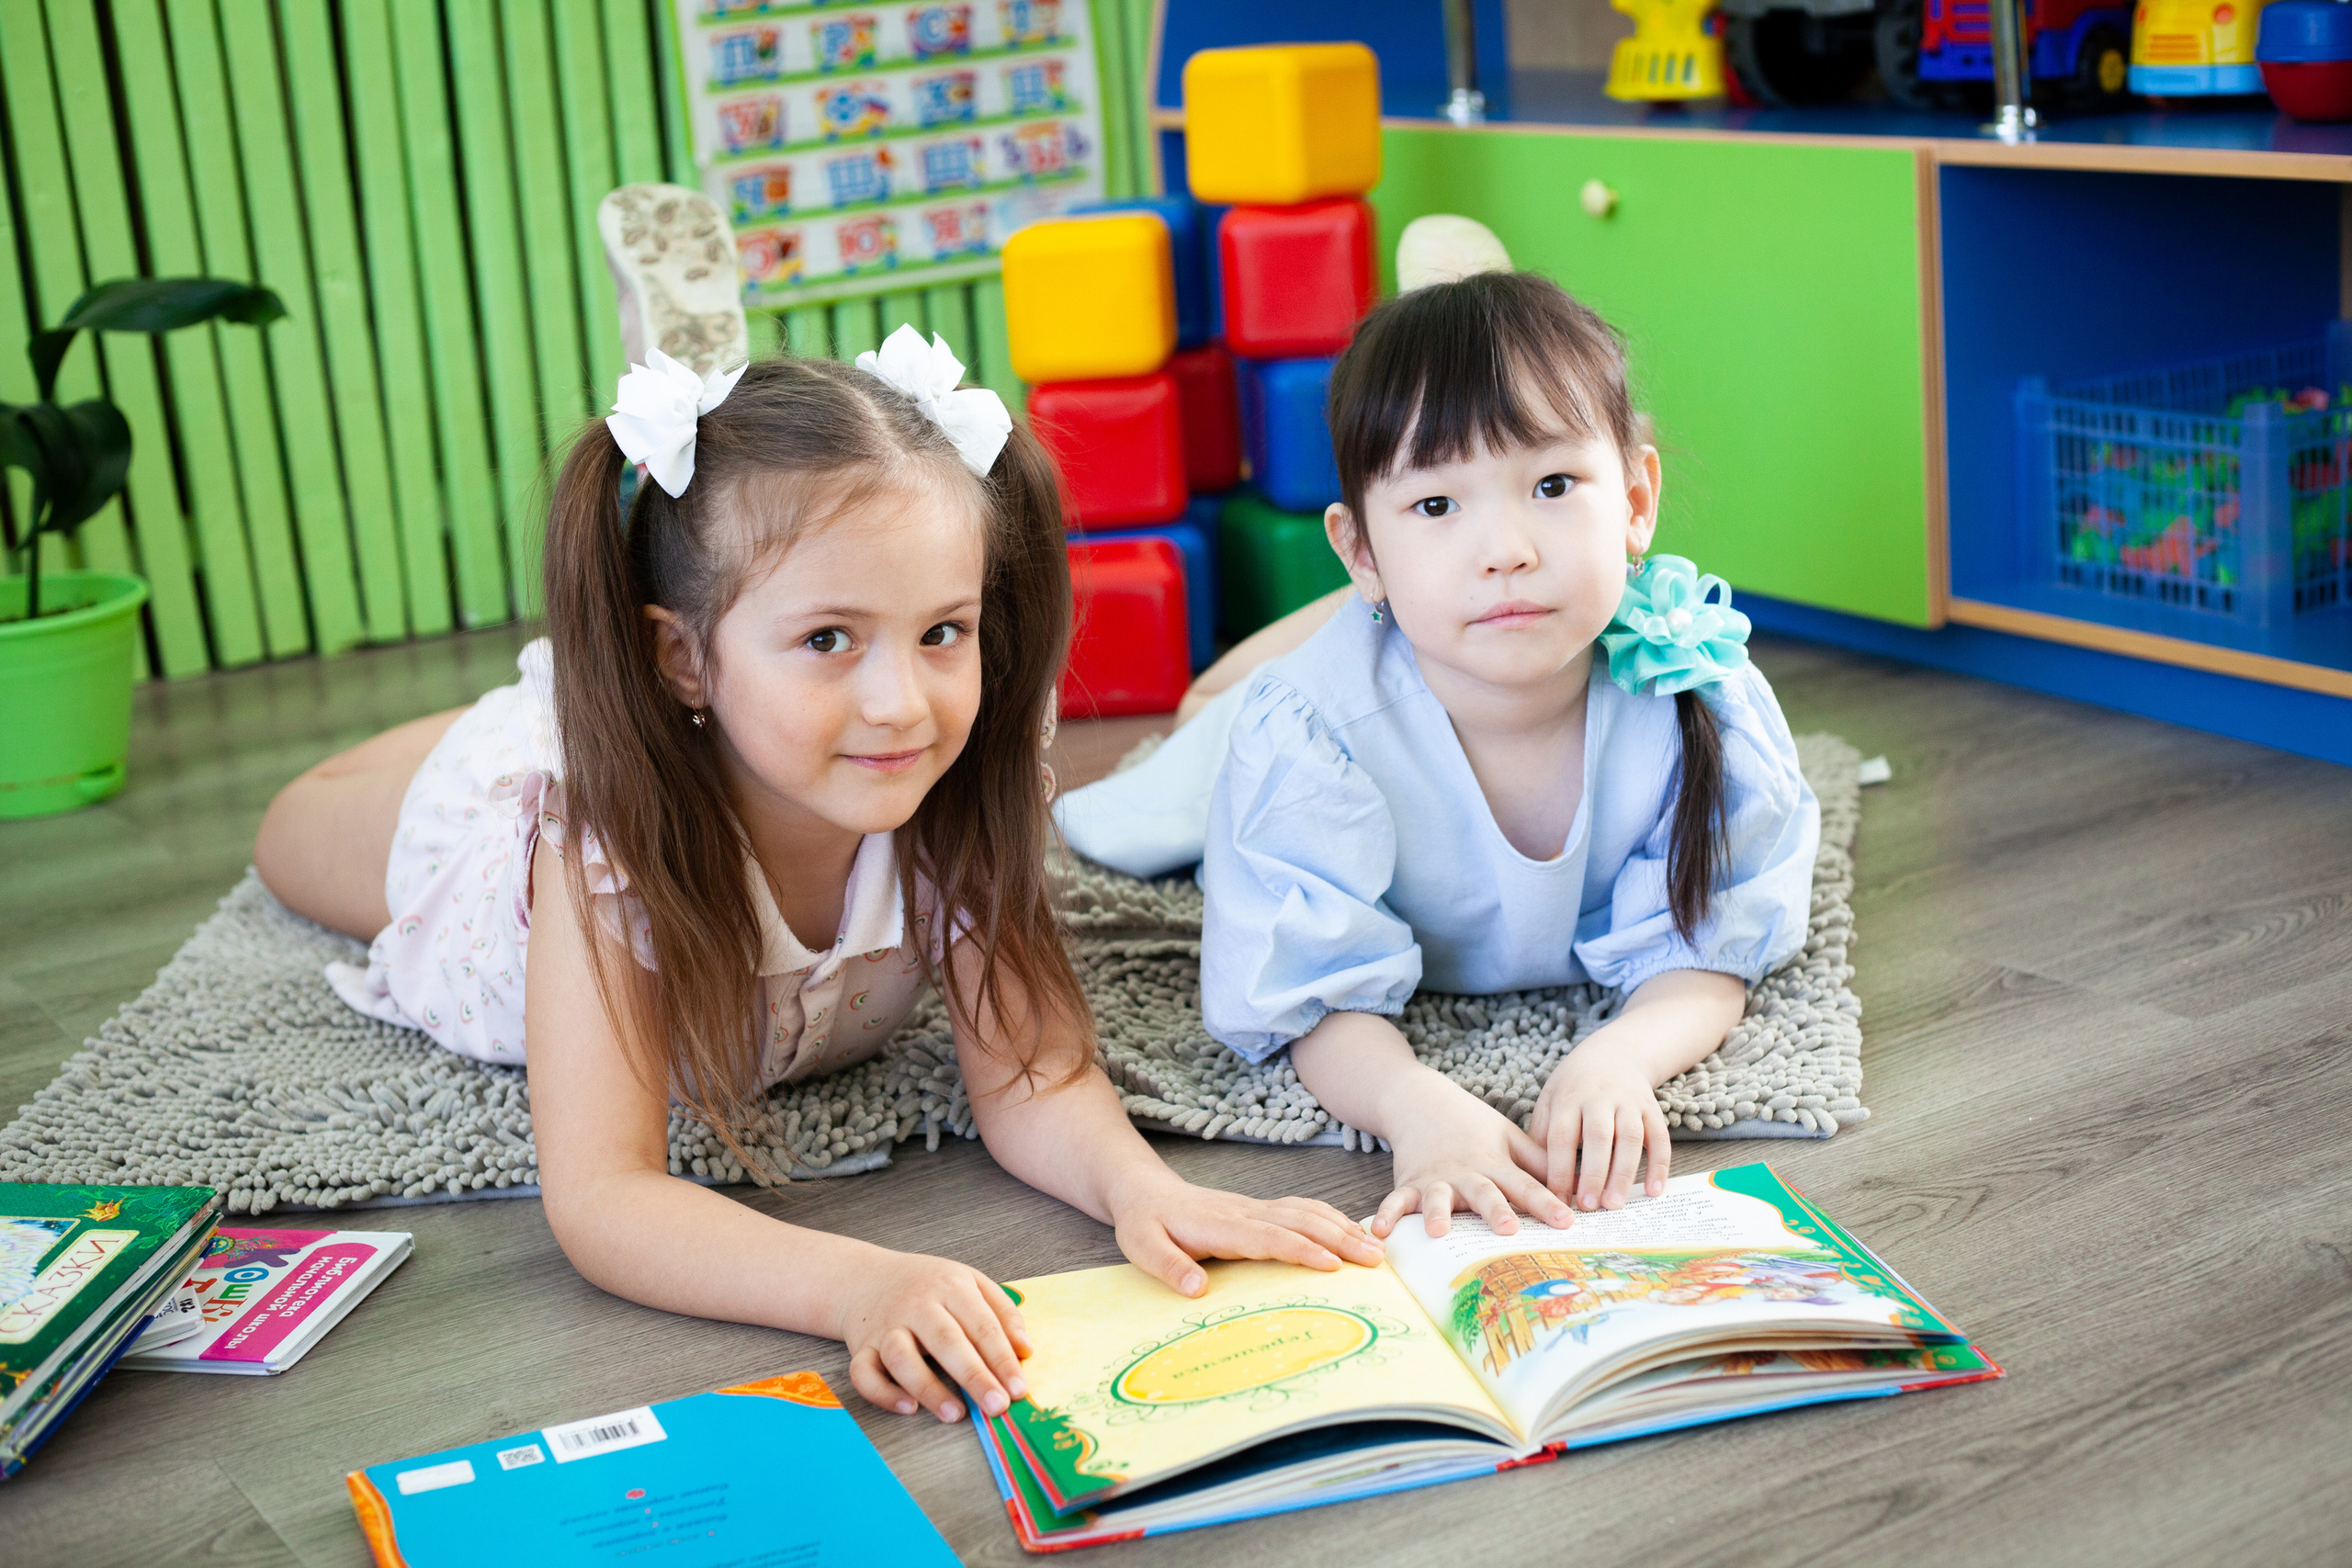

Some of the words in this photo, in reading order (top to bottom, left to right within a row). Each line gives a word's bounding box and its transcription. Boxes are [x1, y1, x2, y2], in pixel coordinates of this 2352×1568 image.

[0, 1240, 120, 1333] СКАЗКИ
[266, 1256, 334, 1312] начальной
[278, 1257, 358, 1317] Библиотека
[223, 1313, 271, 1349] школы
